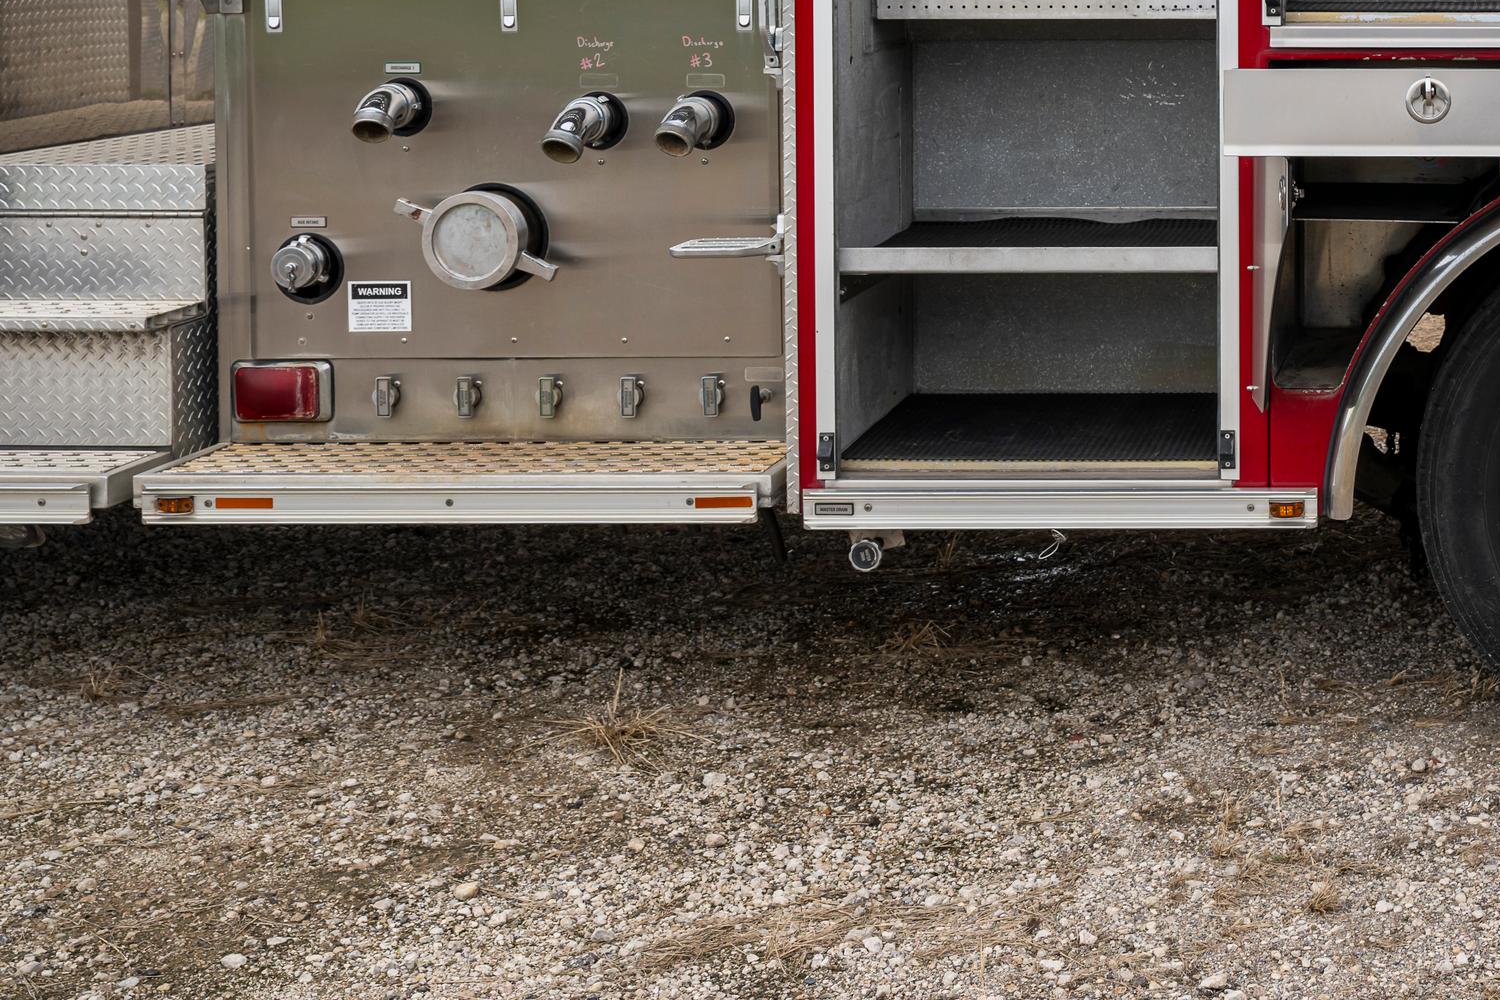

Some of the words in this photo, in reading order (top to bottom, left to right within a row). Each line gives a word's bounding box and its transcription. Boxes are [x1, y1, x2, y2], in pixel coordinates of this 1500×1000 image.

[576, 36, 615, 51] Discharge
[681, 35, 724, 49] Discharge
[580, 53, 605, 70] #2
[690, 52, 713, 68] #3
[357, 287, 402, 296] WARNING
